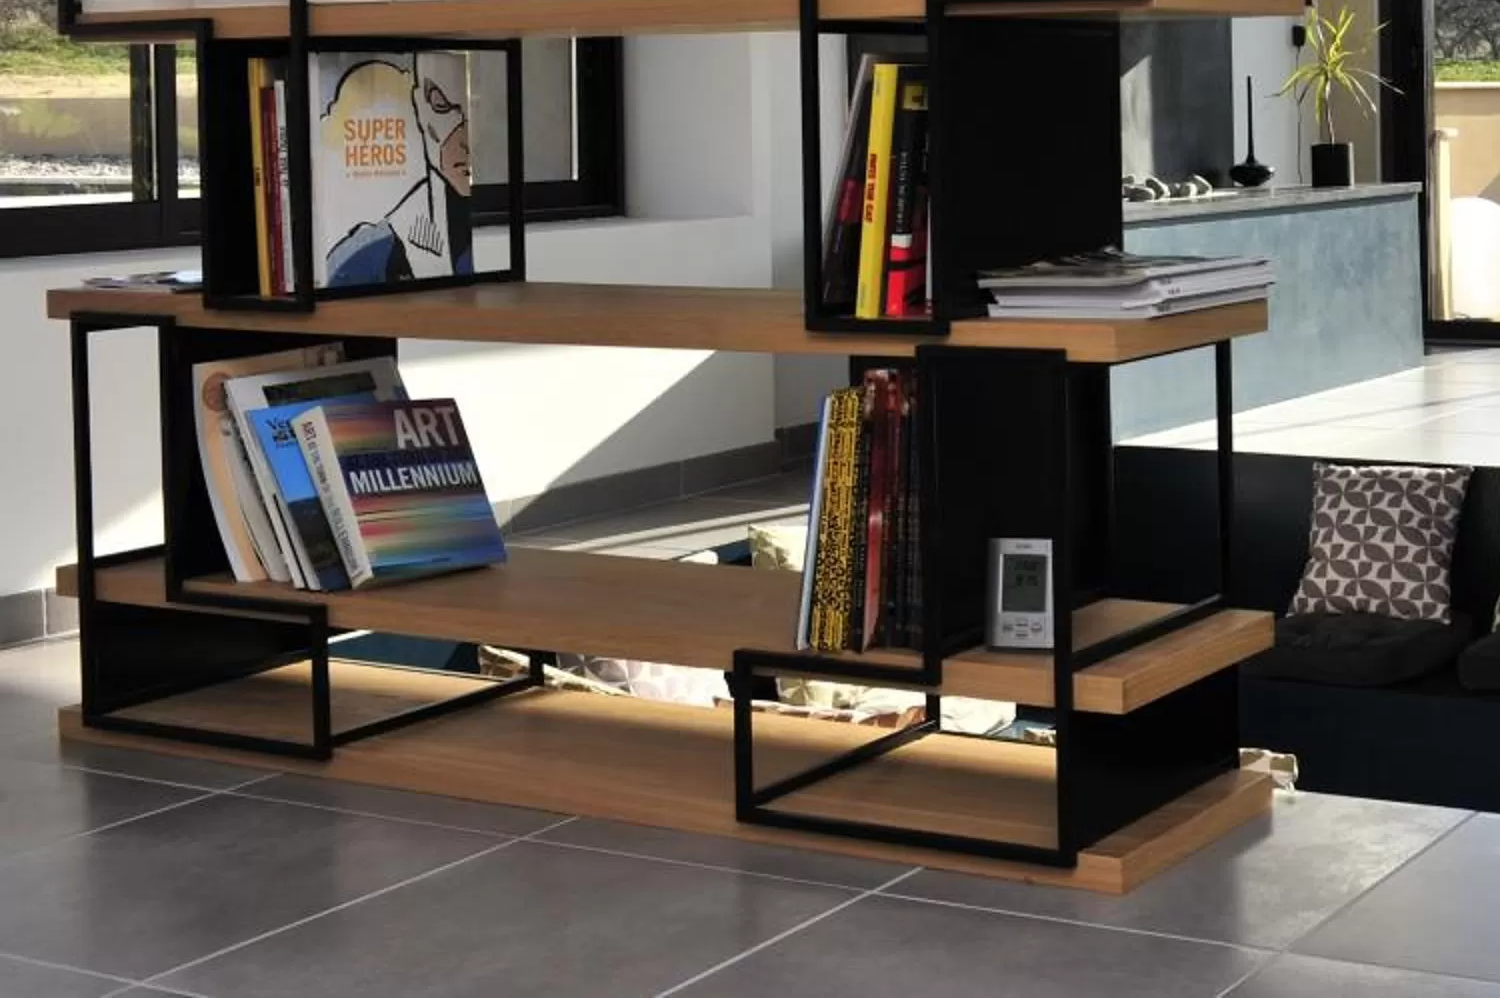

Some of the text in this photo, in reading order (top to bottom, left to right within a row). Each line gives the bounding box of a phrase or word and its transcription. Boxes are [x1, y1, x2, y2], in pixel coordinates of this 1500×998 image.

[343, 118, 406, 140] SUPER
[393, 406, 460, 450] ART
[349, 462, 478, 494] MILLENNIUM
